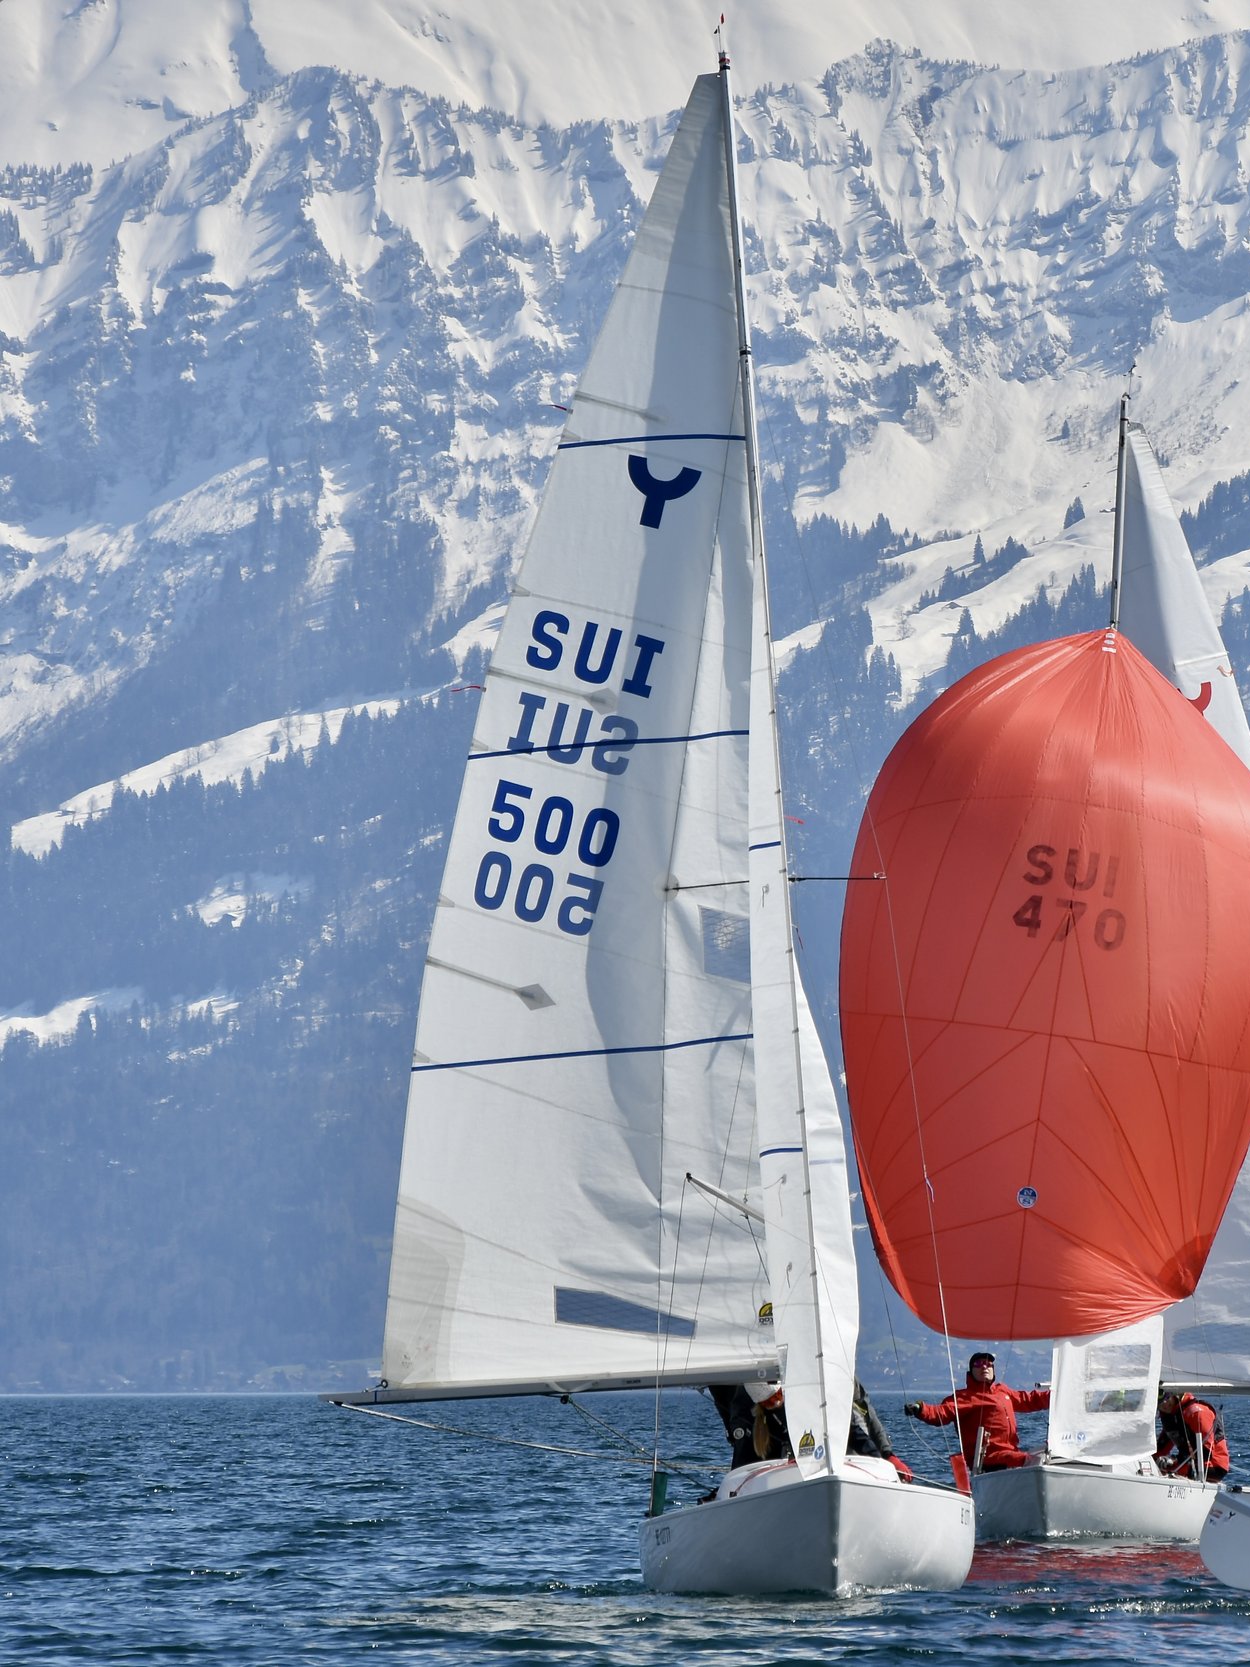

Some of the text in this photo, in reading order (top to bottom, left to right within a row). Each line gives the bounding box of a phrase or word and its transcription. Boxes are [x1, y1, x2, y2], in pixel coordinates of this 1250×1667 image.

[526, 610, 665, 699] SUI
[488, 779, 620, 867] 500
[1022, 844, 1119, 898] SUI
[1012, 895, 1126, 950] 470
